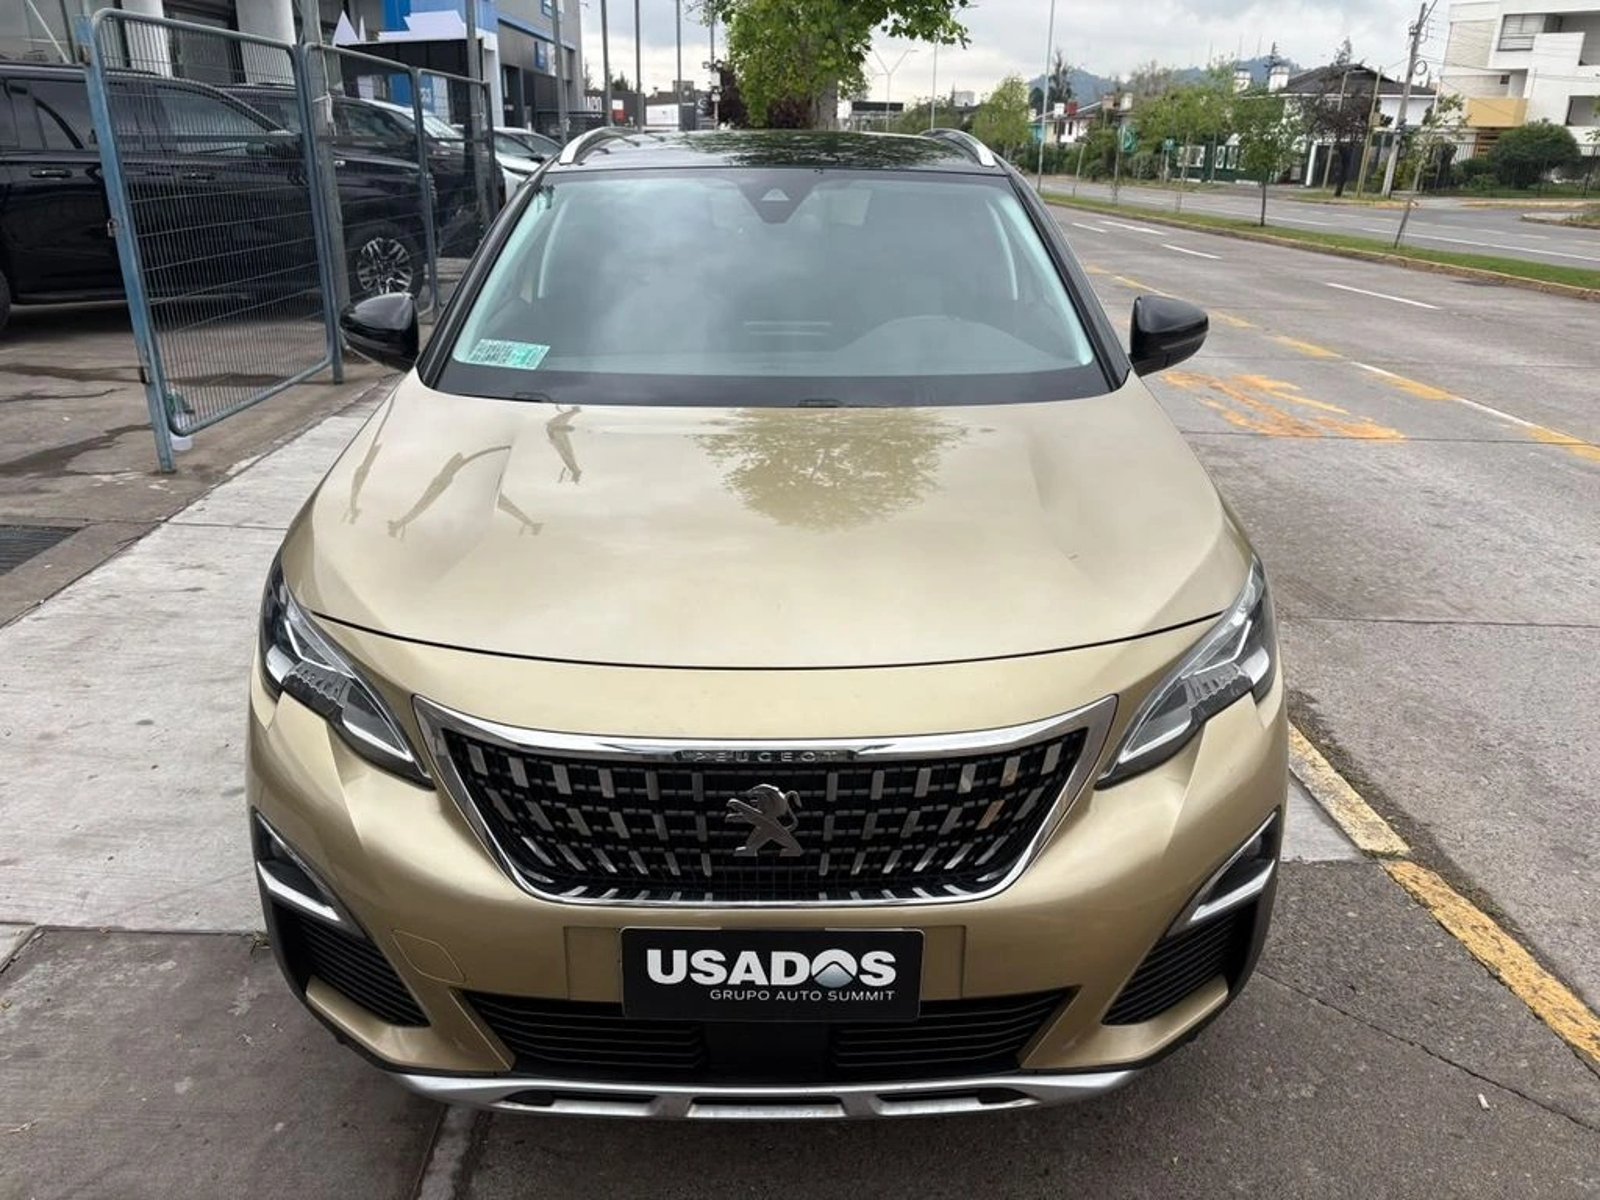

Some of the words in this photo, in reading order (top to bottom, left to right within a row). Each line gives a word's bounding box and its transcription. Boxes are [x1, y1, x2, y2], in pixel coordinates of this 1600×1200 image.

[646, 948, 897, 988] USADOS
[709, 989, 770, 1001] GRUPO
[775, 989, 823, 1001] AUTO
[827, 989, 896, 1002] SUMMIT
